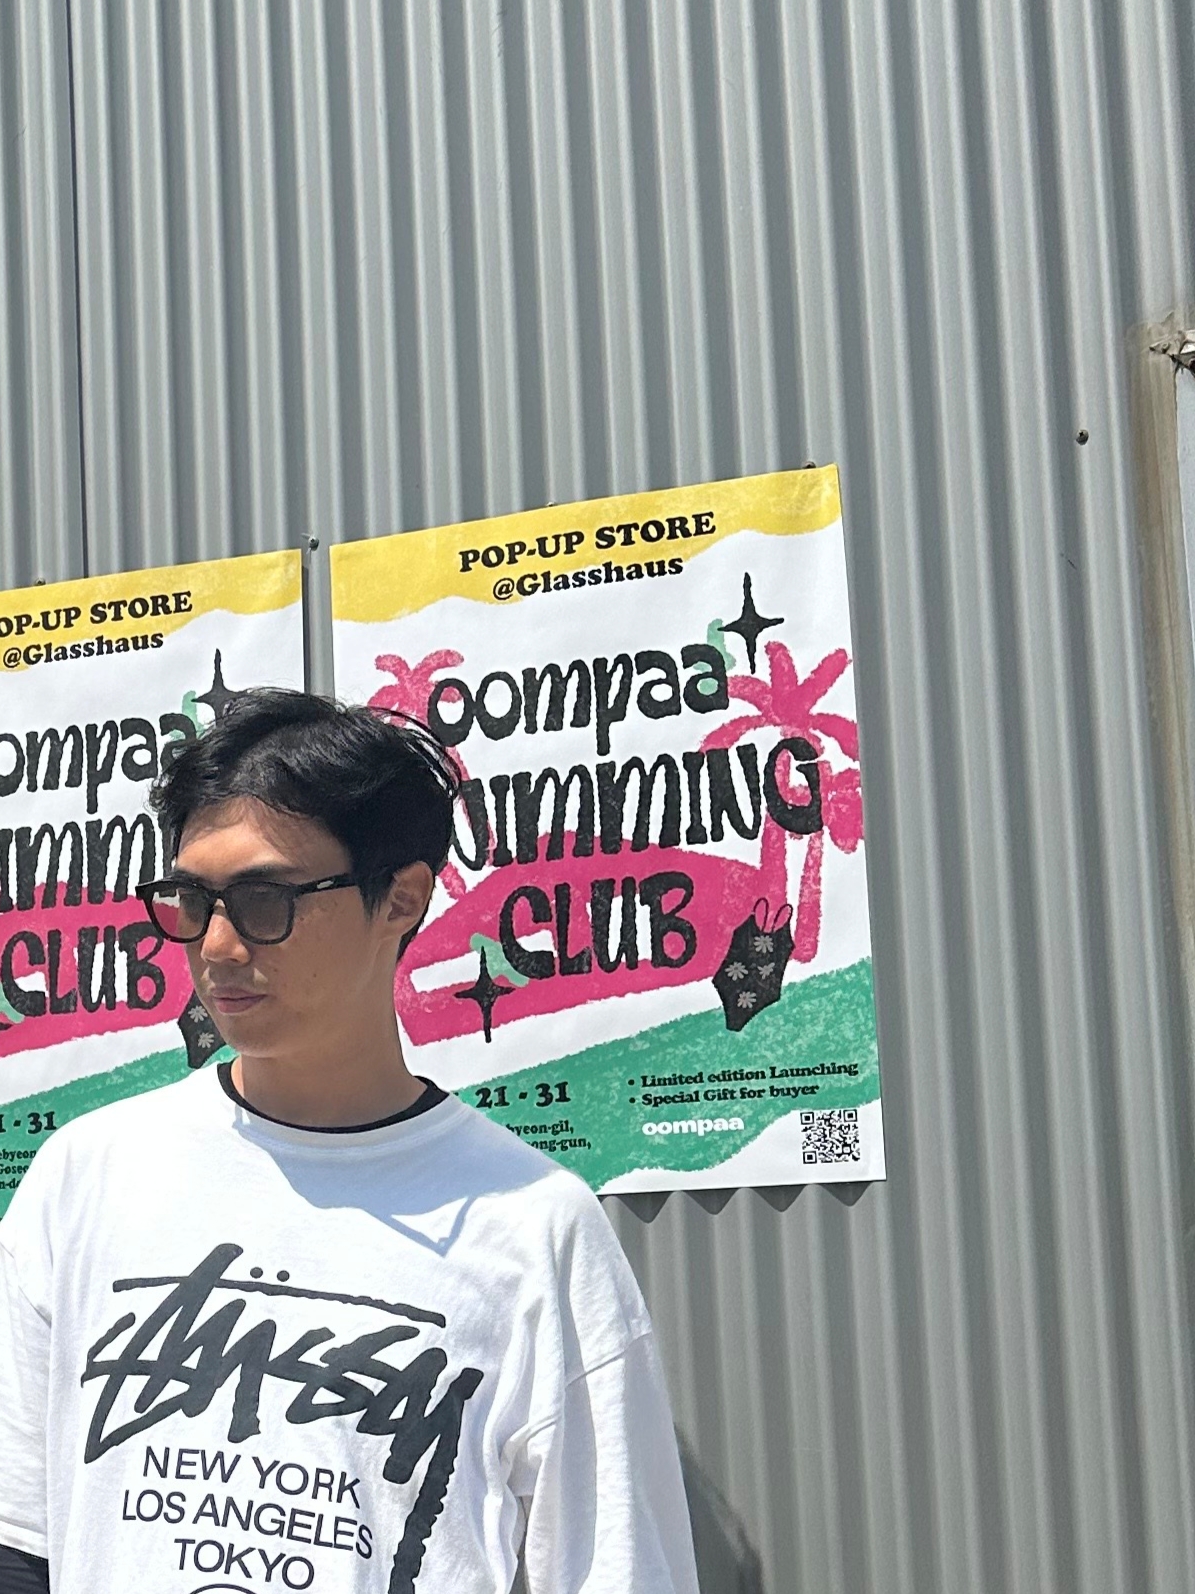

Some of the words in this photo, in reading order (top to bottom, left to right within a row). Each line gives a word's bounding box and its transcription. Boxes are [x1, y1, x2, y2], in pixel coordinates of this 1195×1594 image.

[458, 531, 585, 573] POP-UP
[595, 511, 716, 550] STORE
[492, 557, 684, 601] @Glasshaus
[90, 590, 193, 624] STORE
[2, 633, 164, 669] @Glasshaus
[427, 643, 730, 757] oompaa
[499, 871, 697, 980] CLUB
[1, 921, 166, 1018] CLUB
[475, 1085, 510, 1109] 21
[535, 1081, 572, 1108] 31
[640, 1071, 705, 1088] Limited
[707, 1068, 767, 1083] edition
[769, 1062, 859, 1078] Launching
[641, 1090, 701, 1108] Special
[703, 1088, 737, 1102] Gift
[739, 1087, 766, 1100] for
[768, 1085, 820, 1099] buyer
[27, 1111, 57, 1135] 31
[642, 1117, 745, 1136] oompaa
[143, 1445, 240, 1484] NEW
[253, 1458, 362, 1510] YORK
[122, 1489, 187, 1527] LOS
[192, 1491, 375, 1560] ANGELES
[173, 1538, 315, 1591] TOKYO
